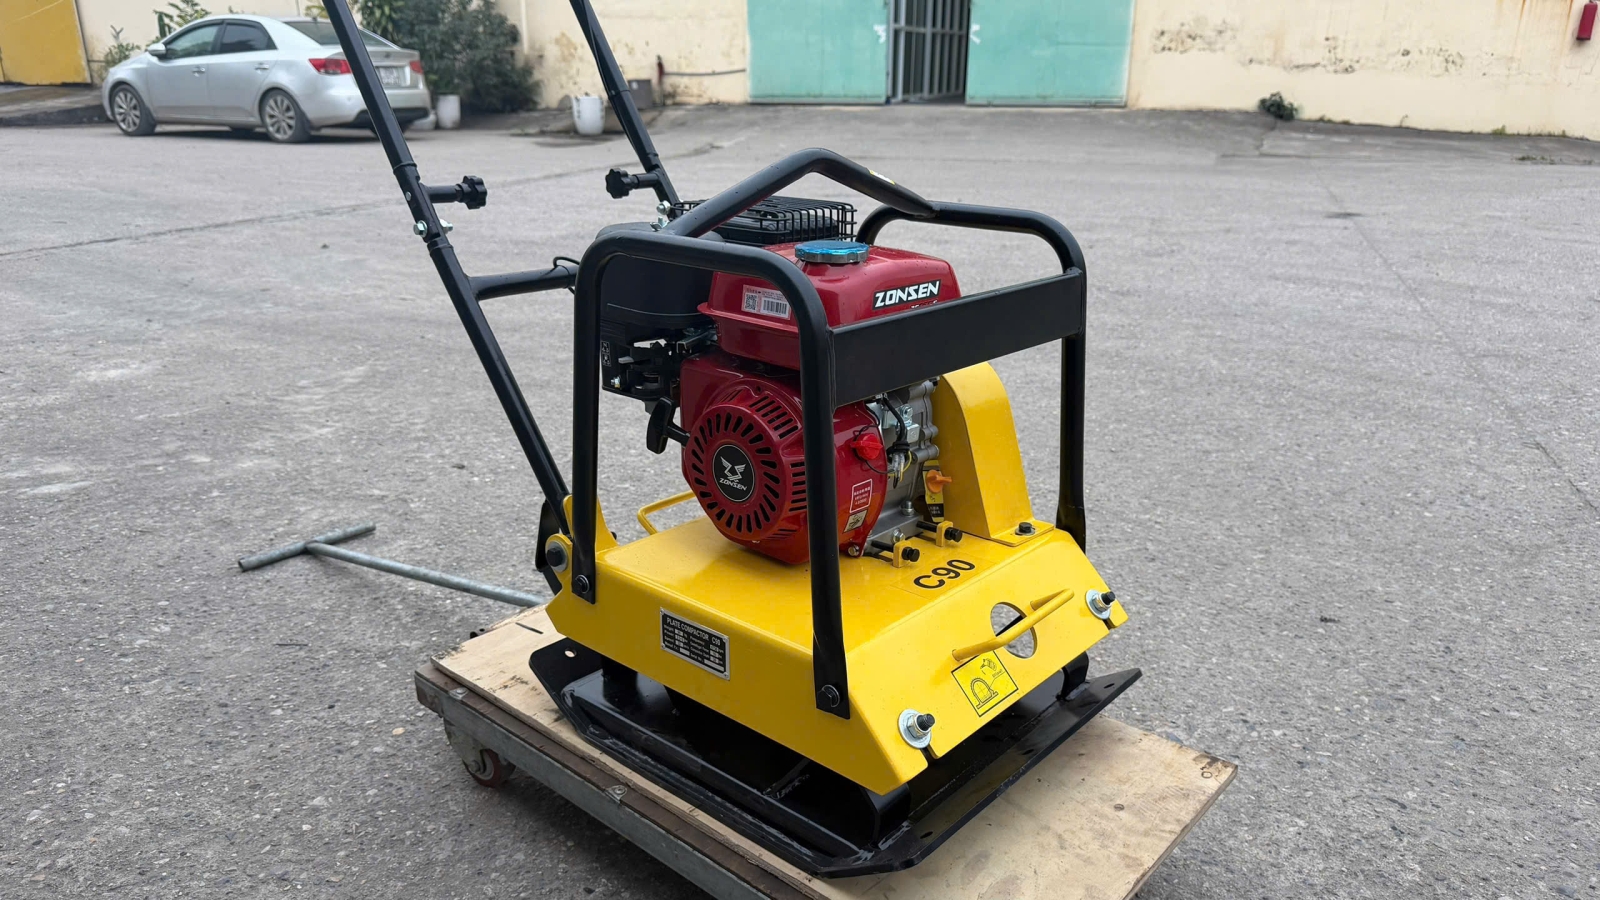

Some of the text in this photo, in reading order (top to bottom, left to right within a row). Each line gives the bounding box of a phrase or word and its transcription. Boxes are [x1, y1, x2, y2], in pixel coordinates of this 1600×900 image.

[875, 281, 940, 308] ZONSEN
[719, 477, 748, 491] ZONSEN
[913, 559, 976, 589] C90
[667, 617, 681, 628] PLATE
[681, 624, 709, 640] COMPACTOR
